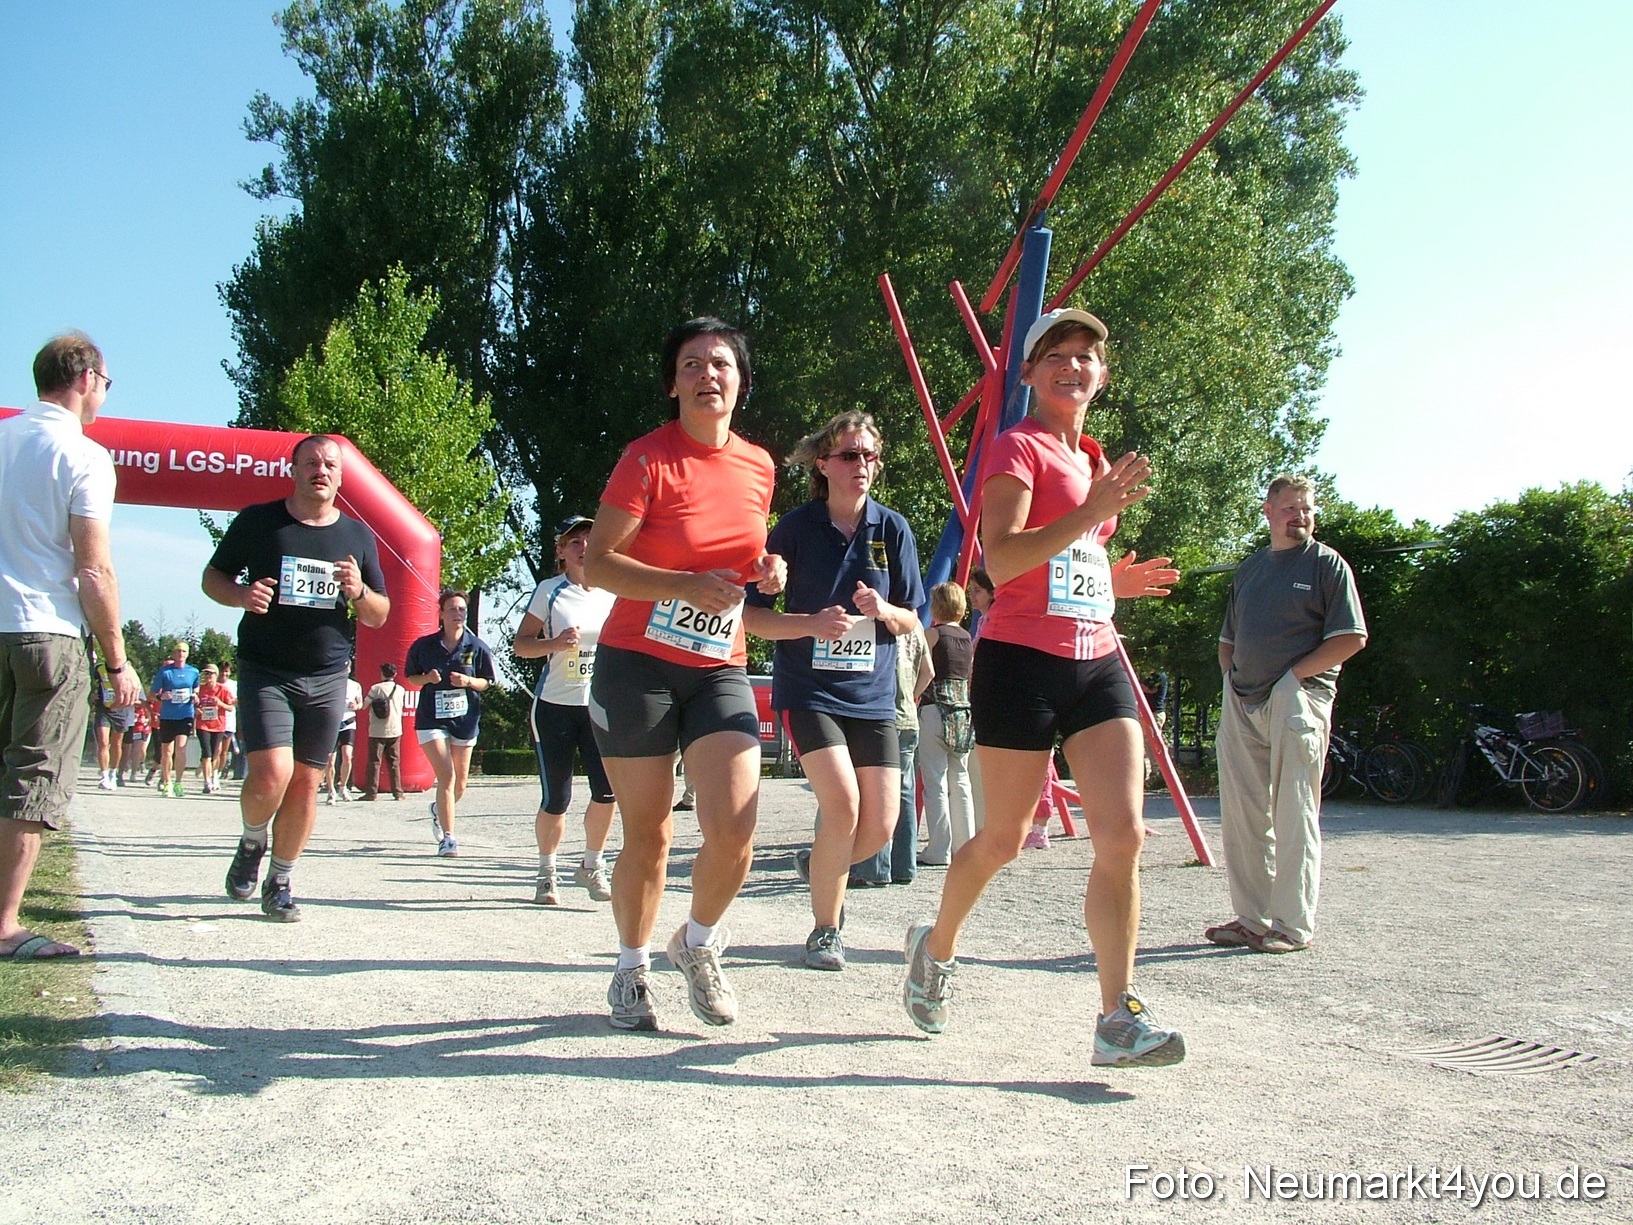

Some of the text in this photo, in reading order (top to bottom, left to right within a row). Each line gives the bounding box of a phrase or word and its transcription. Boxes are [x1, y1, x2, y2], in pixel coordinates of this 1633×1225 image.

[110, 449, 293, 478] ung LGS-Park
[283, 574, 291, 582] C
[1055, 567, 1064, 579] D
[296, 579, 336, 596] 2180
[676, 606, 734, 639] 2604
[831, 640, 872, 656] 2422
